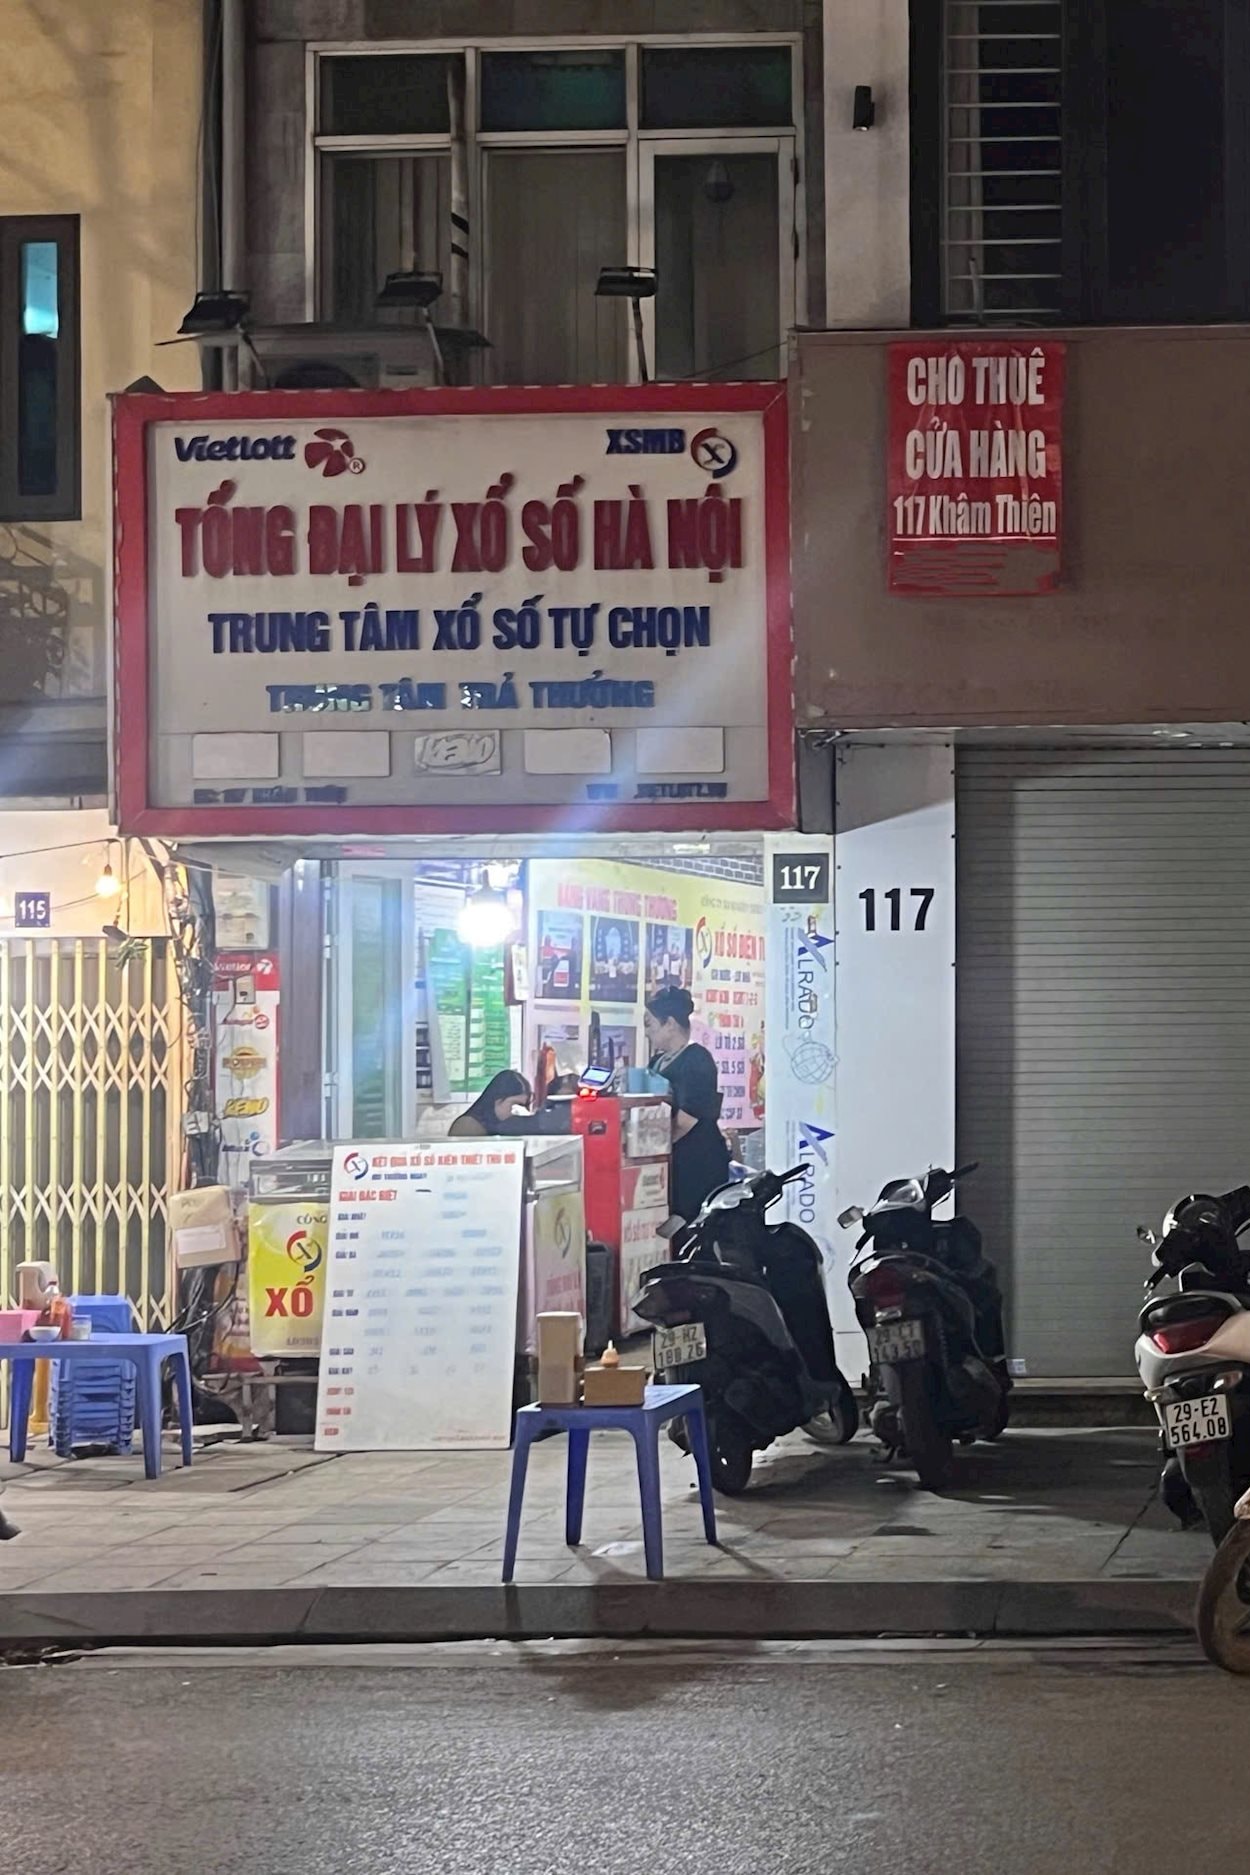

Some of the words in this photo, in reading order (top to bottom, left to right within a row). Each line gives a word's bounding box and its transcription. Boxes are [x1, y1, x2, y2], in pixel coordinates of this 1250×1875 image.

[906, 355, 965, 405] CHO
[972, 347, 1045, 404] THUÊ
[174, 435, 296, 461] Vietlott
[606, 429, 685, 454] XSMB
[905, 416, 963, 479] CỬA
[969, 420, 1047, 478] HÀNG
[307, 504, 385, 586] ĐẠI
[396, 489, 443, 573] LÝ
[451, 472, 514, 573] XỔ
[521, 475, 584, 572] SỐ
[594, 485, 654, 570] HÀ
[667, 483, 743, 583] NỘI
[893, 495, 926, 535] 117
[928, 492, 991, 534] Khâm
[996, 493, 1056, 535] Thiên
[208, 611, 331, 653] TRUNG
[339, 602, 420, 651] TÂM
[433, 592, 483, 650] XỔ
[493, 594, 544, 649] SỐ
[548, 603, 600, 656] TỰ
[608, 606, 710, 656] CHỌN
[780, 866, 821, 890] 117
[19, 899, 46, 920] 115
[858, 887, 934, 931] 117
[265, 1275, 315, 1317] XỔ
[1171, 1417, 1226, 1444] 564.08
